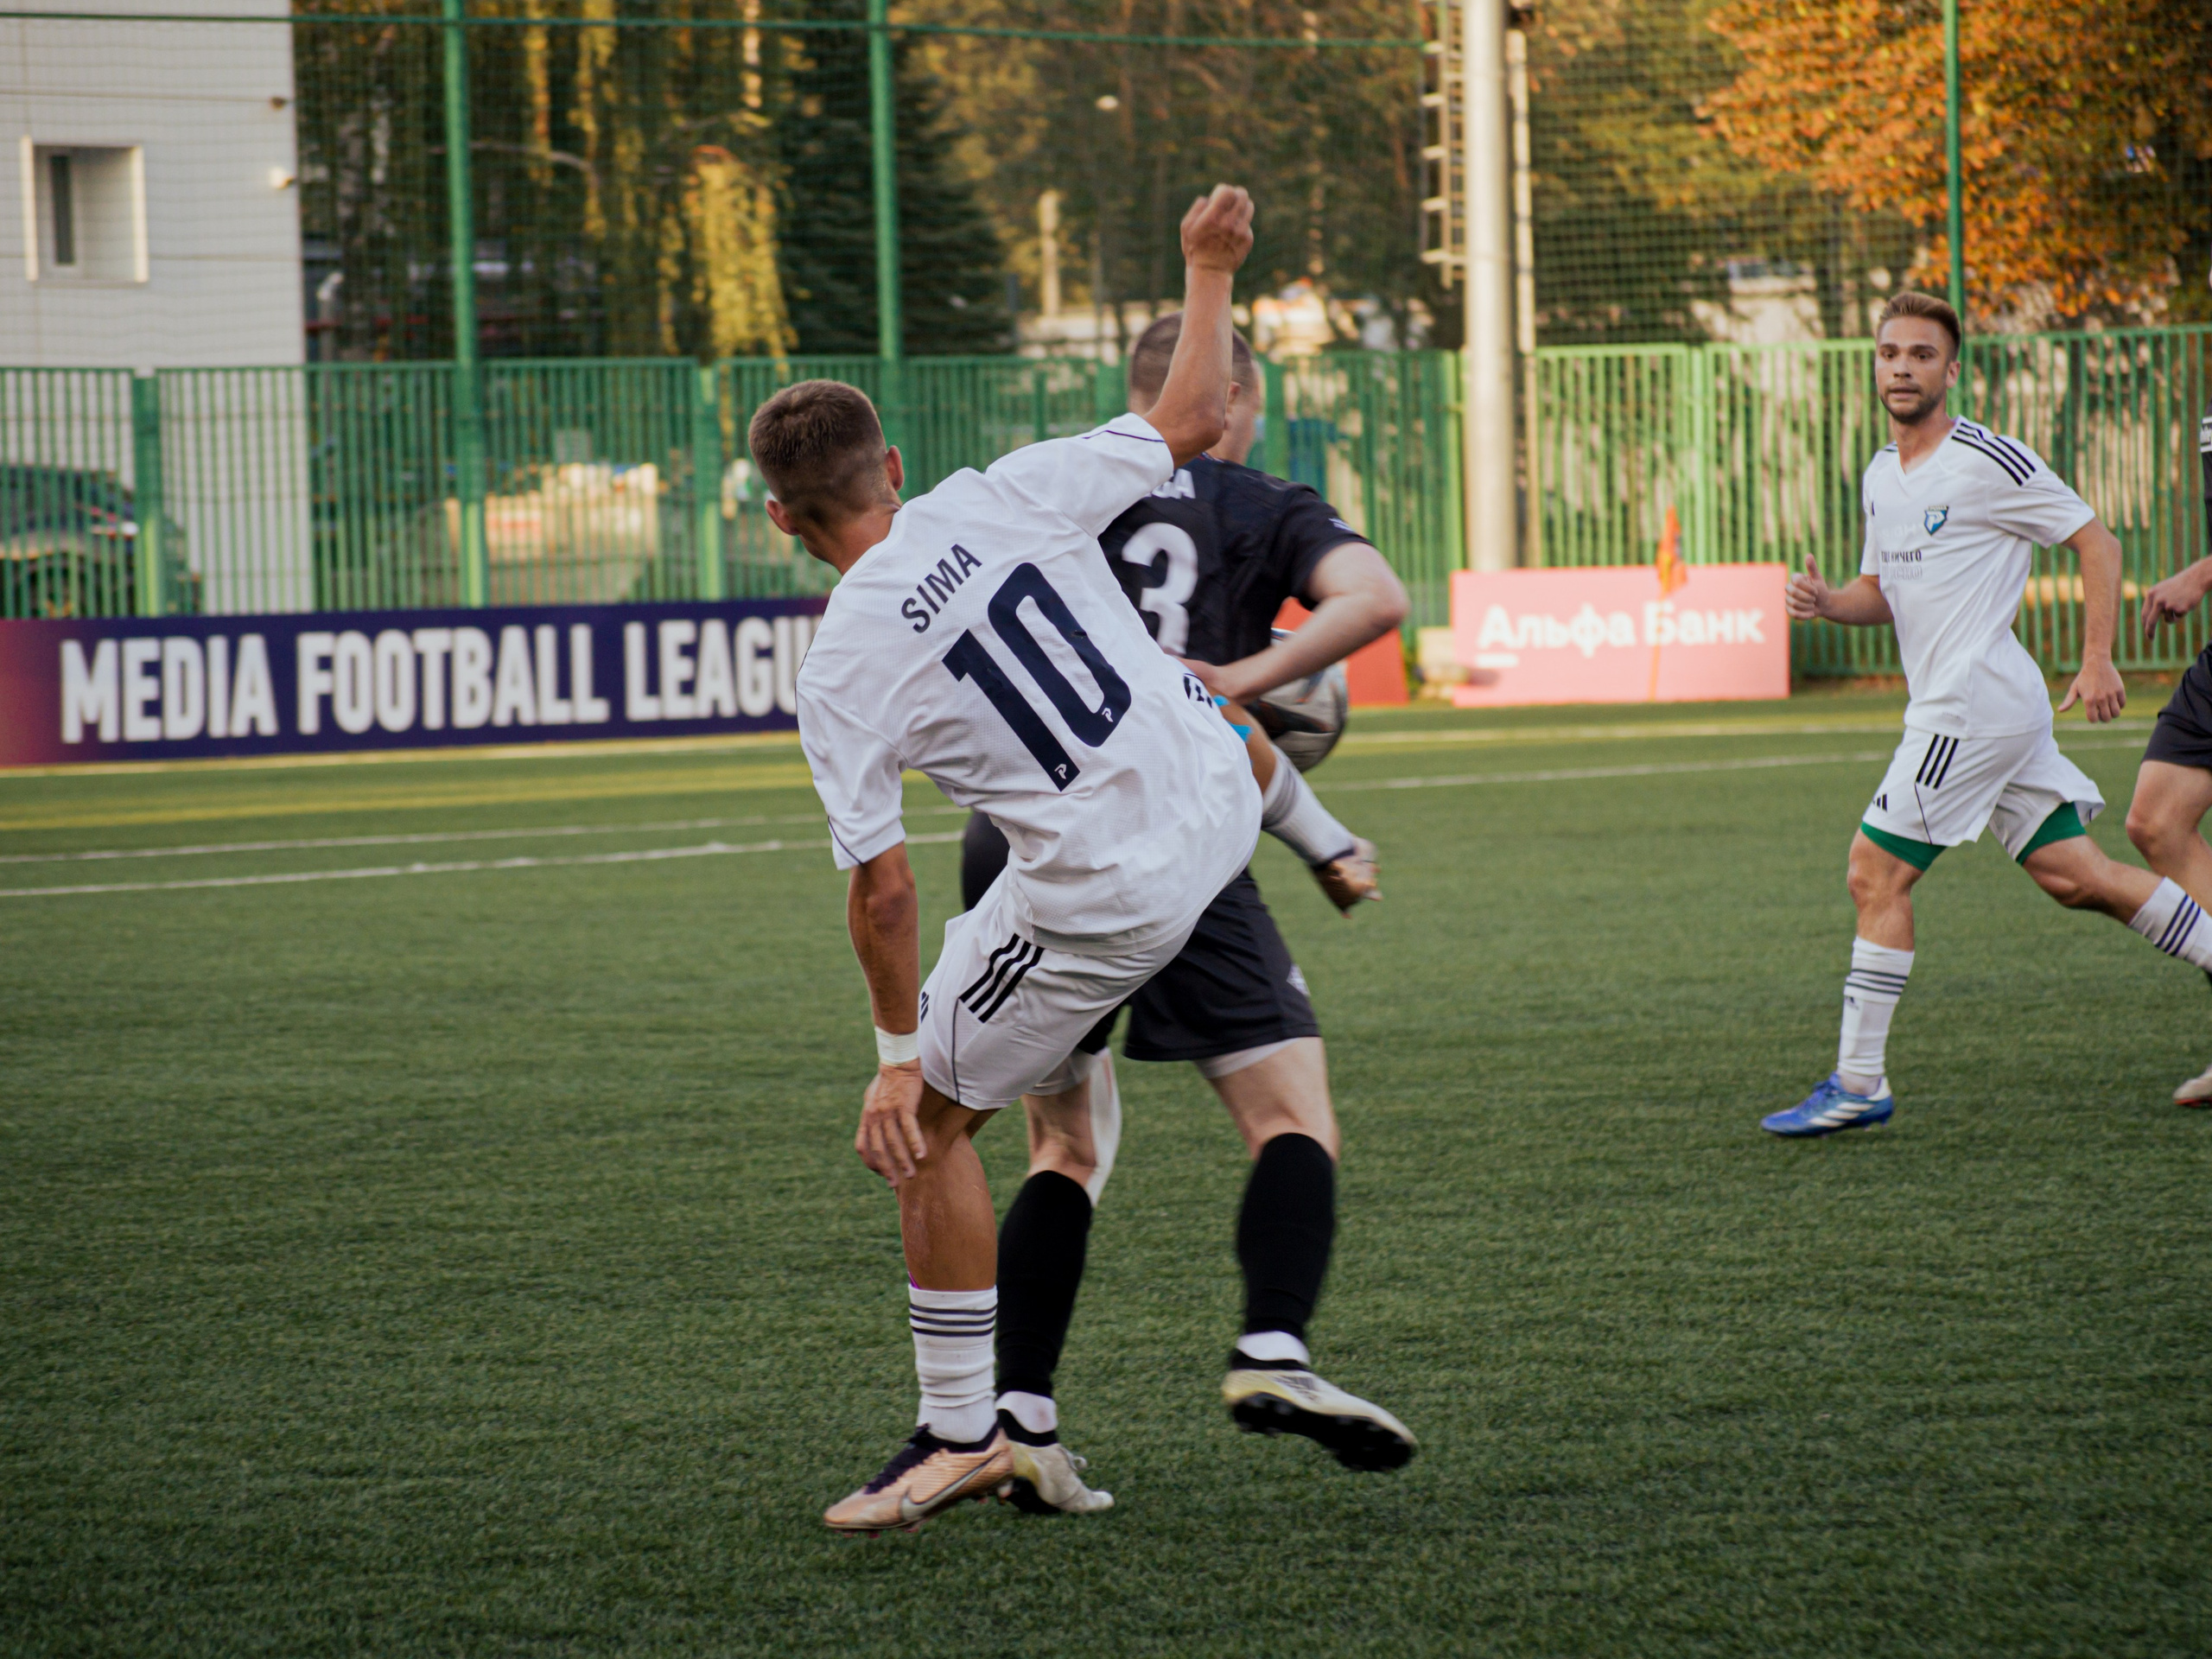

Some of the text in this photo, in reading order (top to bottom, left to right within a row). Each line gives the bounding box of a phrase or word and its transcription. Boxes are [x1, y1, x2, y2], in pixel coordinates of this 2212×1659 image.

[901, 543, 982, 633] SIMA
[1477, 601, 1765, 658] Альфа Банк
[60, 614, 822, 743] MEDIA FOOTBALL LEAGU
[941, 562, 1132, 792] 10
